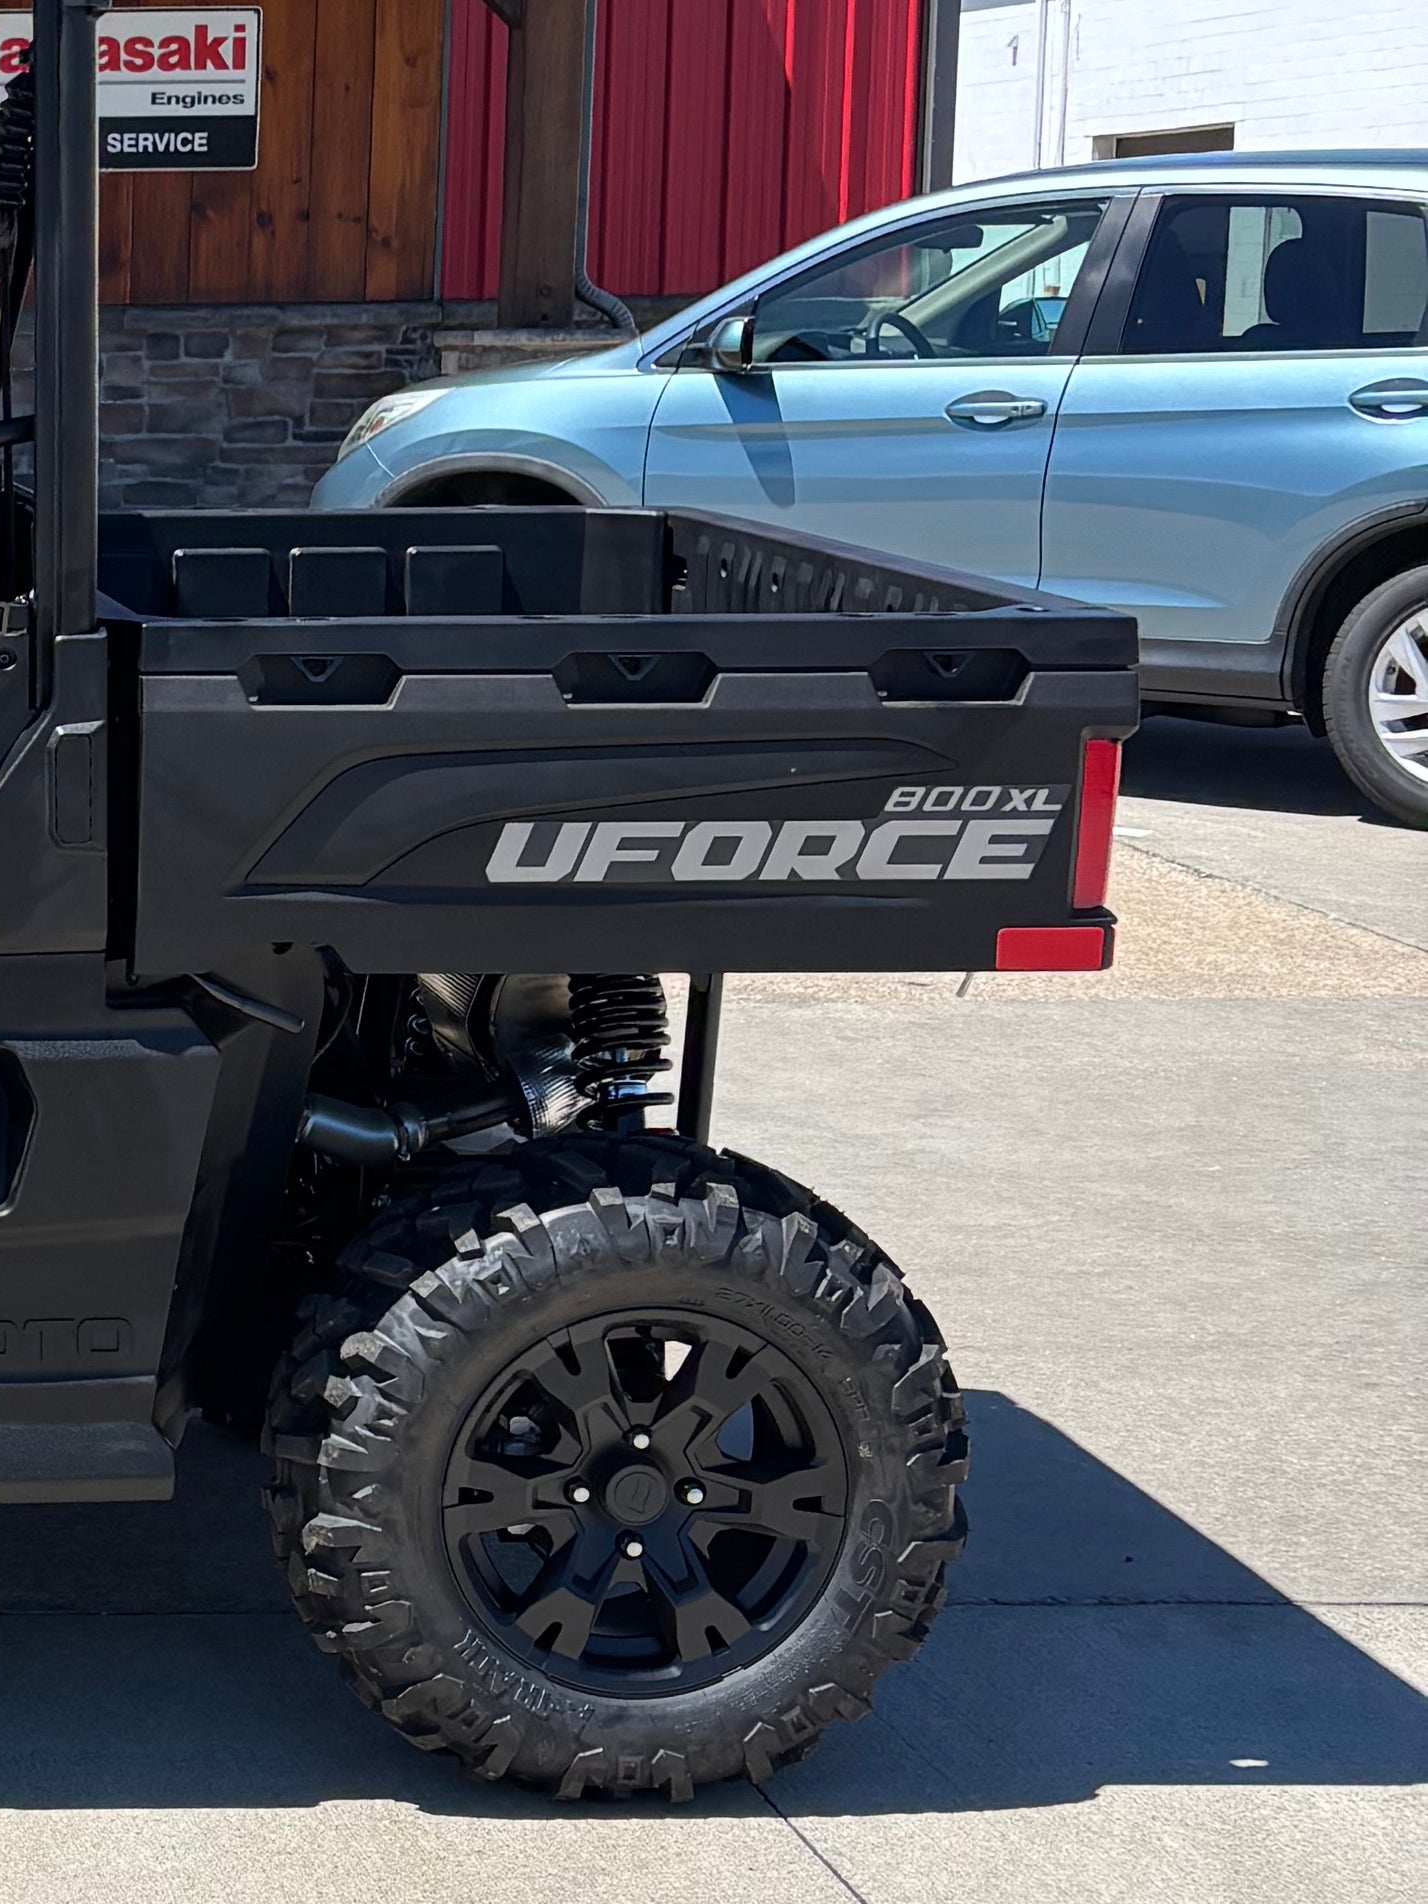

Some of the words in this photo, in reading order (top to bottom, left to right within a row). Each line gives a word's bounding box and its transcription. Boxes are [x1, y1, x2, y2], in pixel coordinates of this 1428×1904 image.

[150, 91, 245, 109] Engines
[106, 131, 208, 153] SERVICE
[485, 818, 1055, 883] UFORCE
